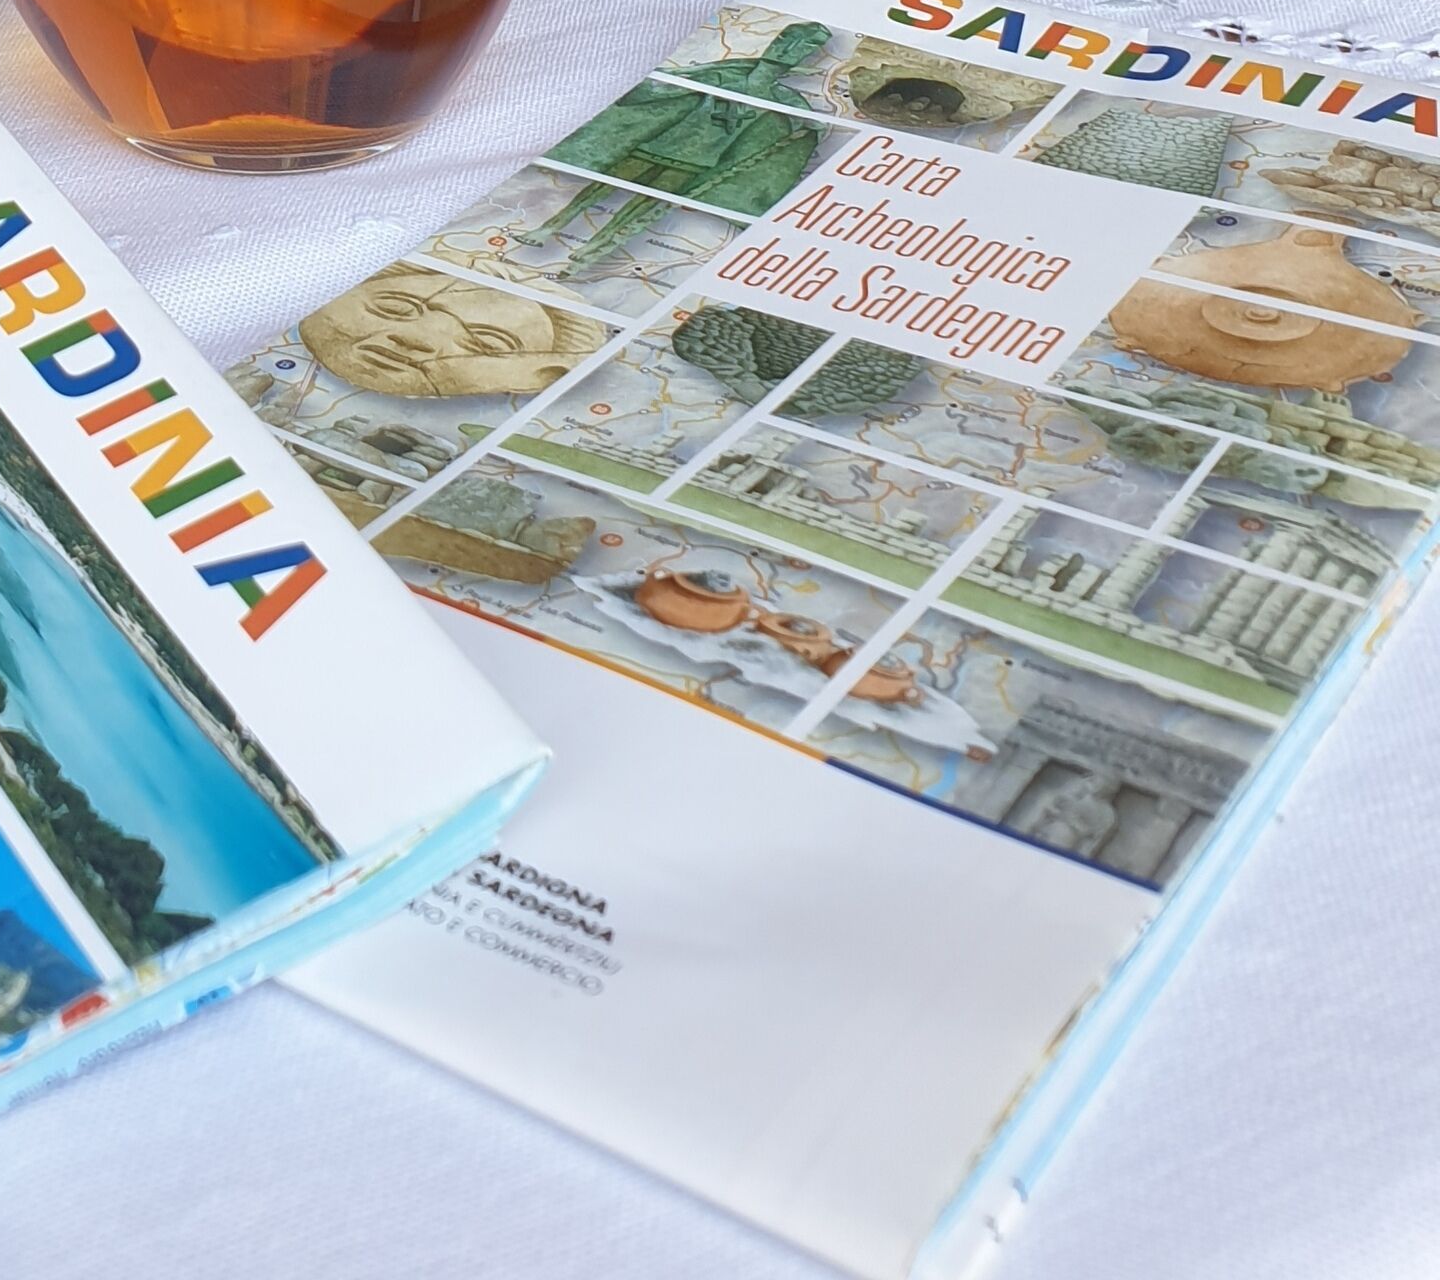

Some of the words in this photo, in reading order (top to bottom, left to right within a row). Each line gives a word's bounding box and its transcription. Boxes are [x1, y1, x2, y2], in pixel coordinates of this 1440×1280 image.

[836, 134, 962, 198] Carta
[772, 184, 1072, 292] Archeologica
[717, 237, 840, 301] della
[831, 264, 1066, 365] Sardegna
